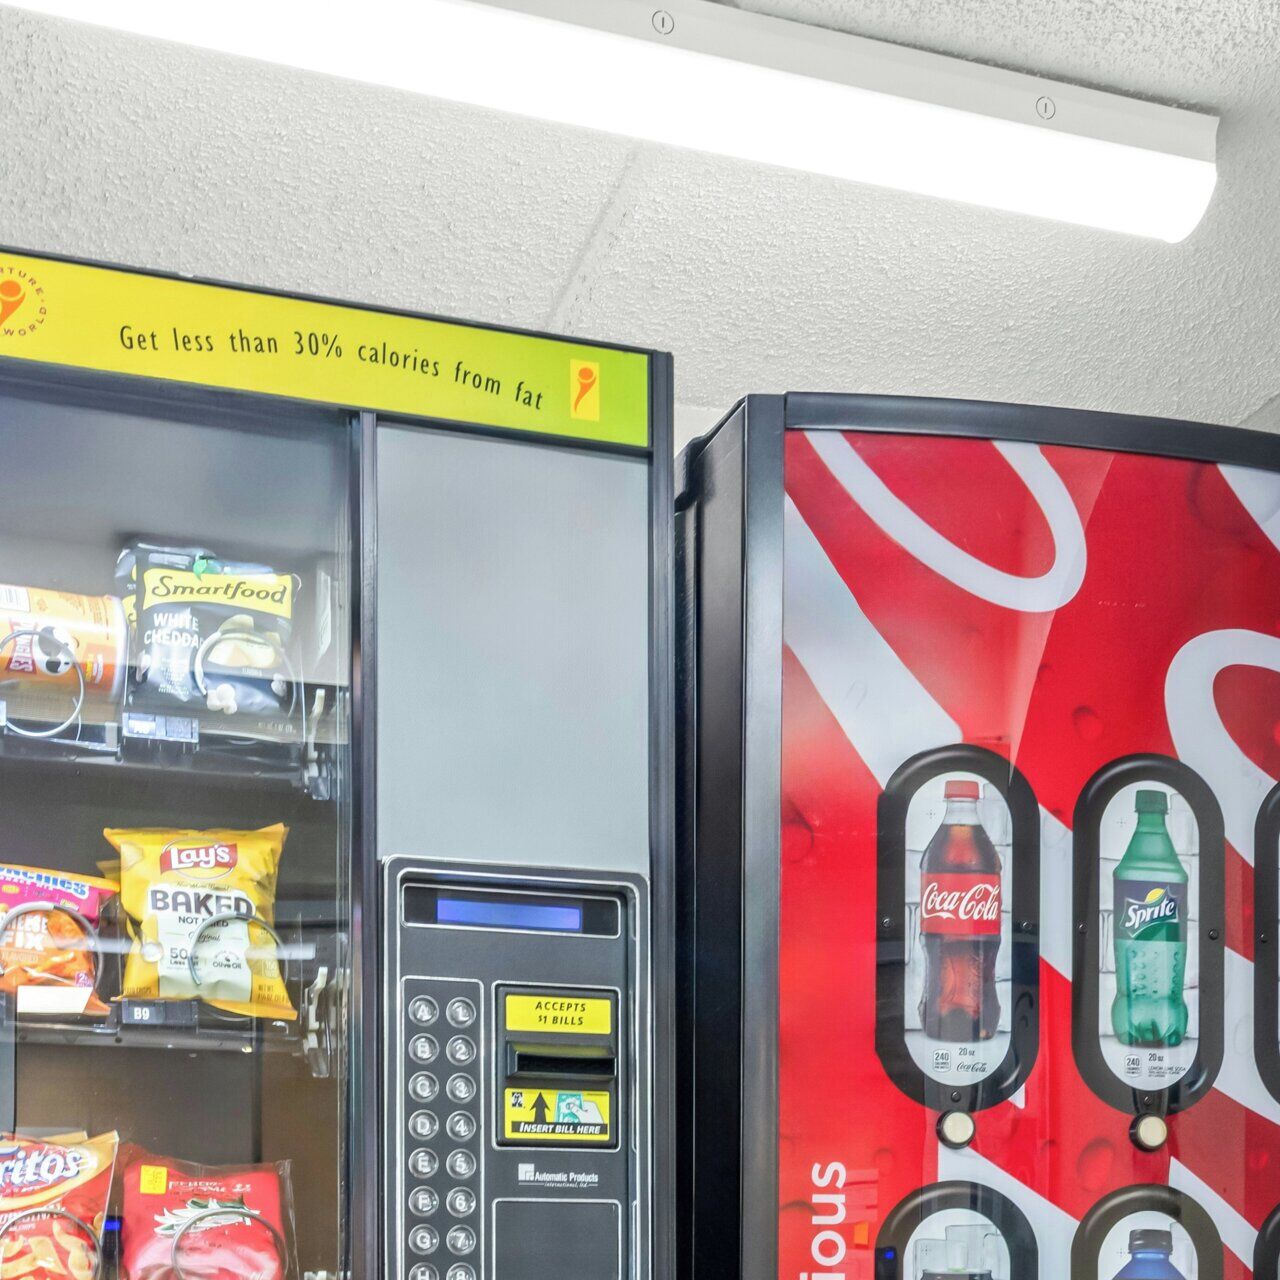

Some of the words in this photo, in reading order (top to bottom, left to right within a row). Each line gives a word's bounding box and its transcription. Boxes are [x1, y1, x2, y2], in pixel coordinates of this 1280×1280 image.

[119, 325, 160, 352] Get
[172, 327, 215, 354] less
[229, 329, 279, 354] than
[294, 330, 343, 358] 30%
[357, 340, 441, 378] calories
[454, 361, 502, 396] from
[514, 382, 545, 411] fat
[151, 575, 288, 605] Smartfood
[169, 843, 234, 869] Lay's
[921, 882, 999, 922] Coca-Cola
[1124, 898, 1175, 930] Sprite
[133, 1007, 150, 1020] B9
[417, 1005, 432, 1020] A
[535, 1001, 586, 1013] ACCEPTS
[538, 1014, 548, 1025] $1
[552, 1015, 584, 1026] BILLS
[417, 1041, 432, 1058] B
[454, 1042, 468, 1060] 2
[934, 1052, 950, 1062] 240
[1148, 1053, 1157, 1062] 20
[1126, 1057, 1140, 1067] 240
[417, 1080, 432, 1096] C
[454, 1081, 468, 1097] 3
[417, 1117, 432, 1134] D
[454, 1117, 468, 1134] 4
[520, 1122, 555, 1134] INSERT
[555, 1123, 575, 1134] BILL
[576, 1124, 602, 1135] HERE
[417, 1155, 432, 1172] E
[454, 1154, 468, 1172] 5
[534, 1171, 568, 1183] Automatic
[569, 1172, 599, 1183] Products
[417, 1193, 432, 1211] F
[454, 1193, 468, 1210] 6
[417, 1232, 432, 1249] G
[454, 1232, 468, 1249] 7
